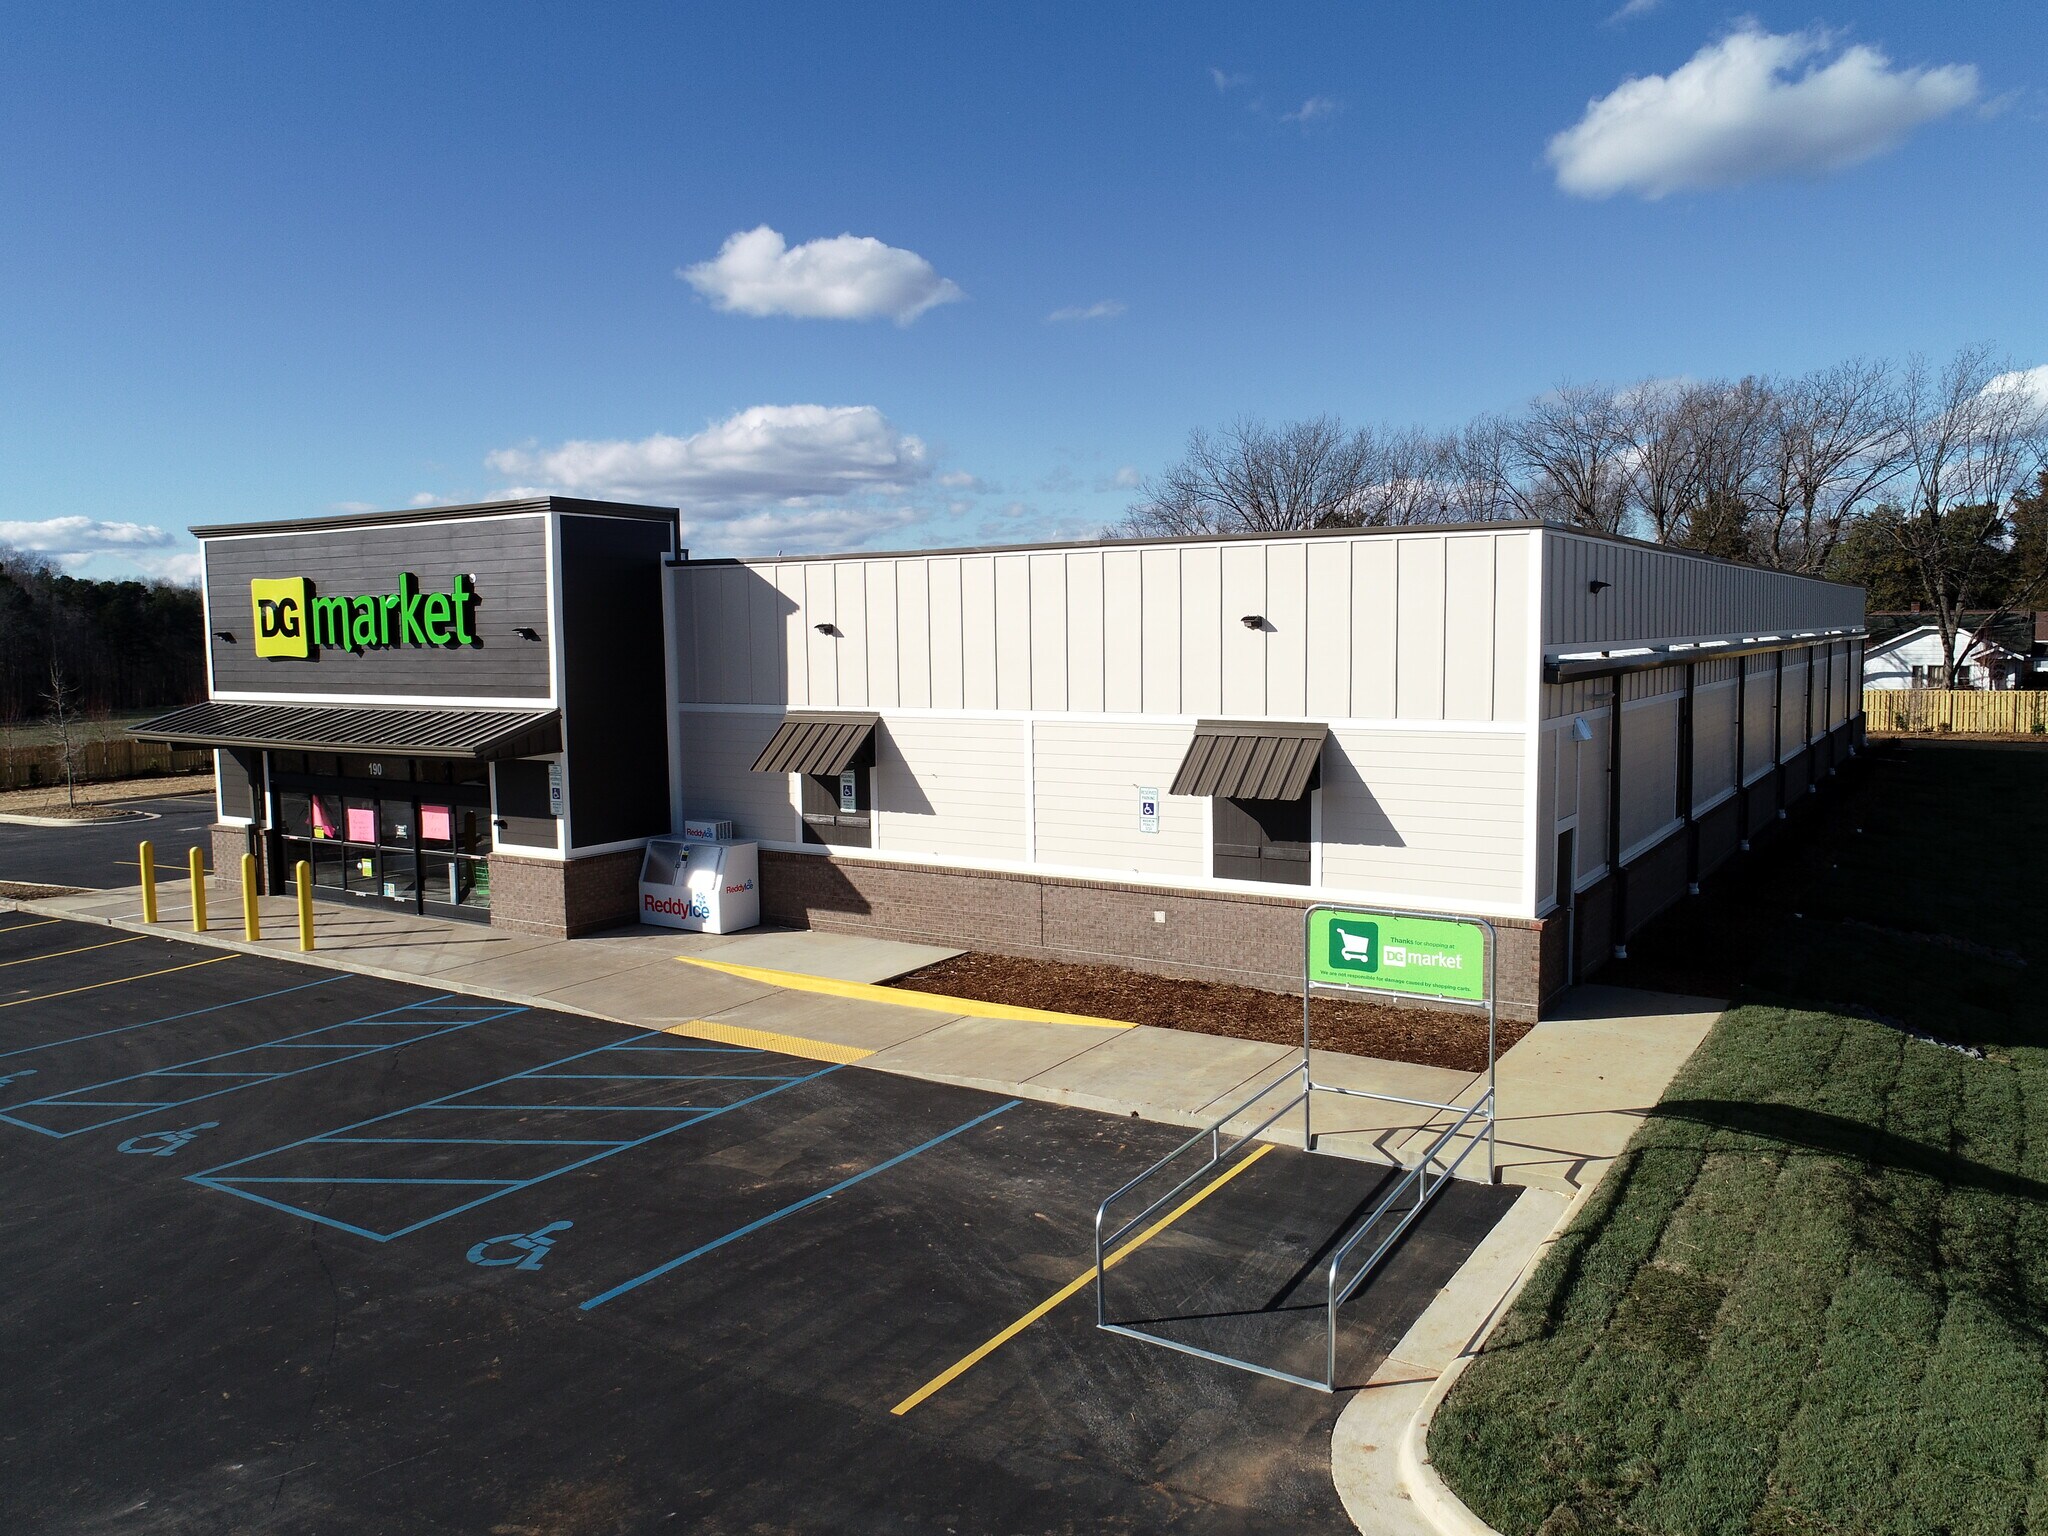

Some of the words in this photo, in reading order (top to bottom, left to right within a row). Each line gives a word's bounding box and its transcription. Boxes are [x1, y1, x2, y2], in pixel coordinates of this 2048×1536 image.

[257, 597, 300, 638] DG
[311, 572, 473, 653] market
[368, 762, 382, 776] 190
[1390, 936, 1414, 945] Thanks
[1423, 941, 1449, 949] shopping
[1386, 950, 1404, 962] DG
[1407, 951, 1463, 969] market
[1347, 973, 1376, 981] responsible
[1405, 979, 1425, 987] caused
[1432, 982, 1457, 991] shopping
